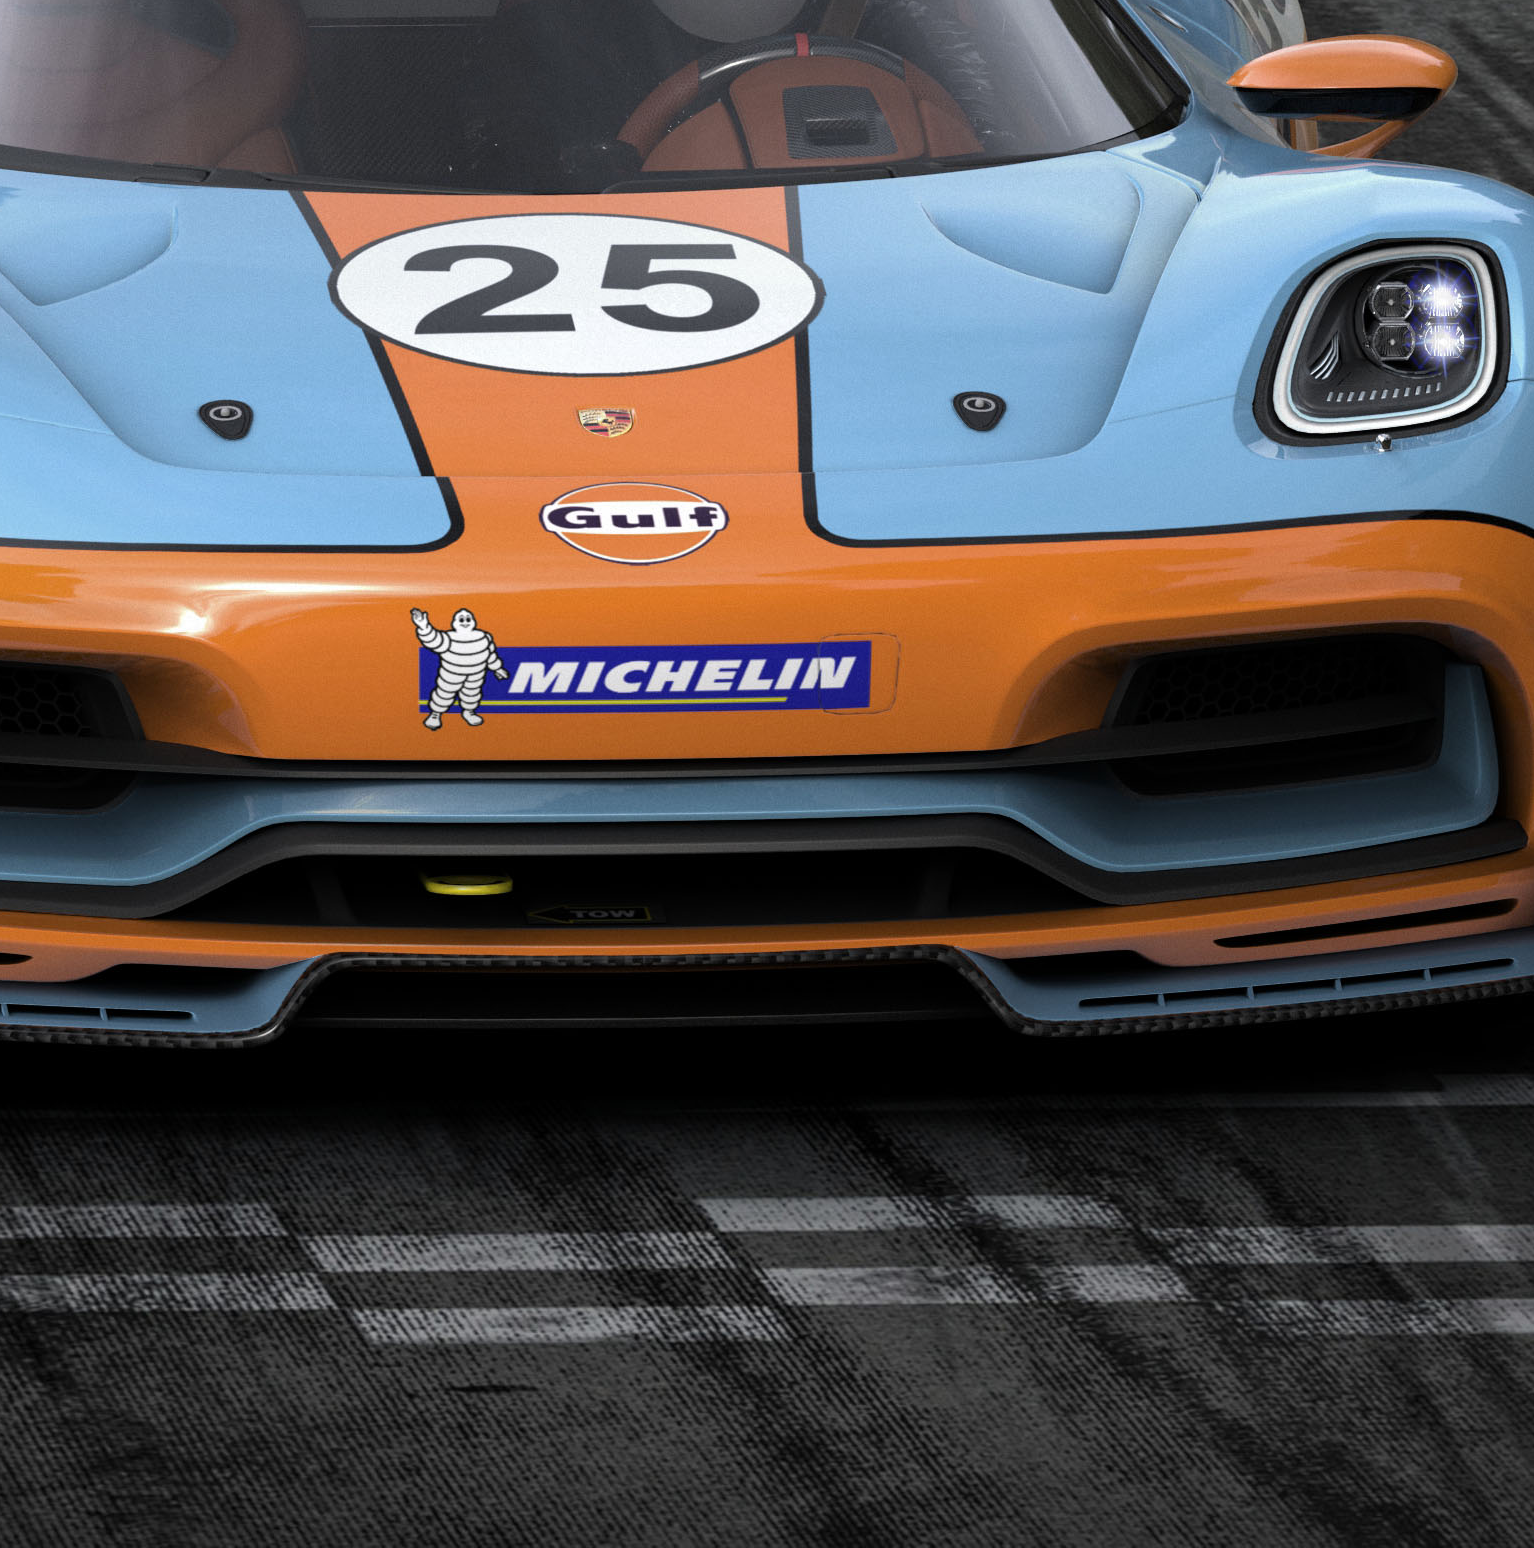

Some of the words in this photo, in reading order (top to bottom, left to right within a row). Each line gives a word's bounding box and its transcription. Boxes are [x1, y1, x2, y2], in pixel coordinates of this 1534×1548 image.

[403, 244, 760, 335] 25
[547, 505, 720, 530] Gulf
[507, 655, 857, 694] MICHELIN
[571, 909, 635, 919] TOW
